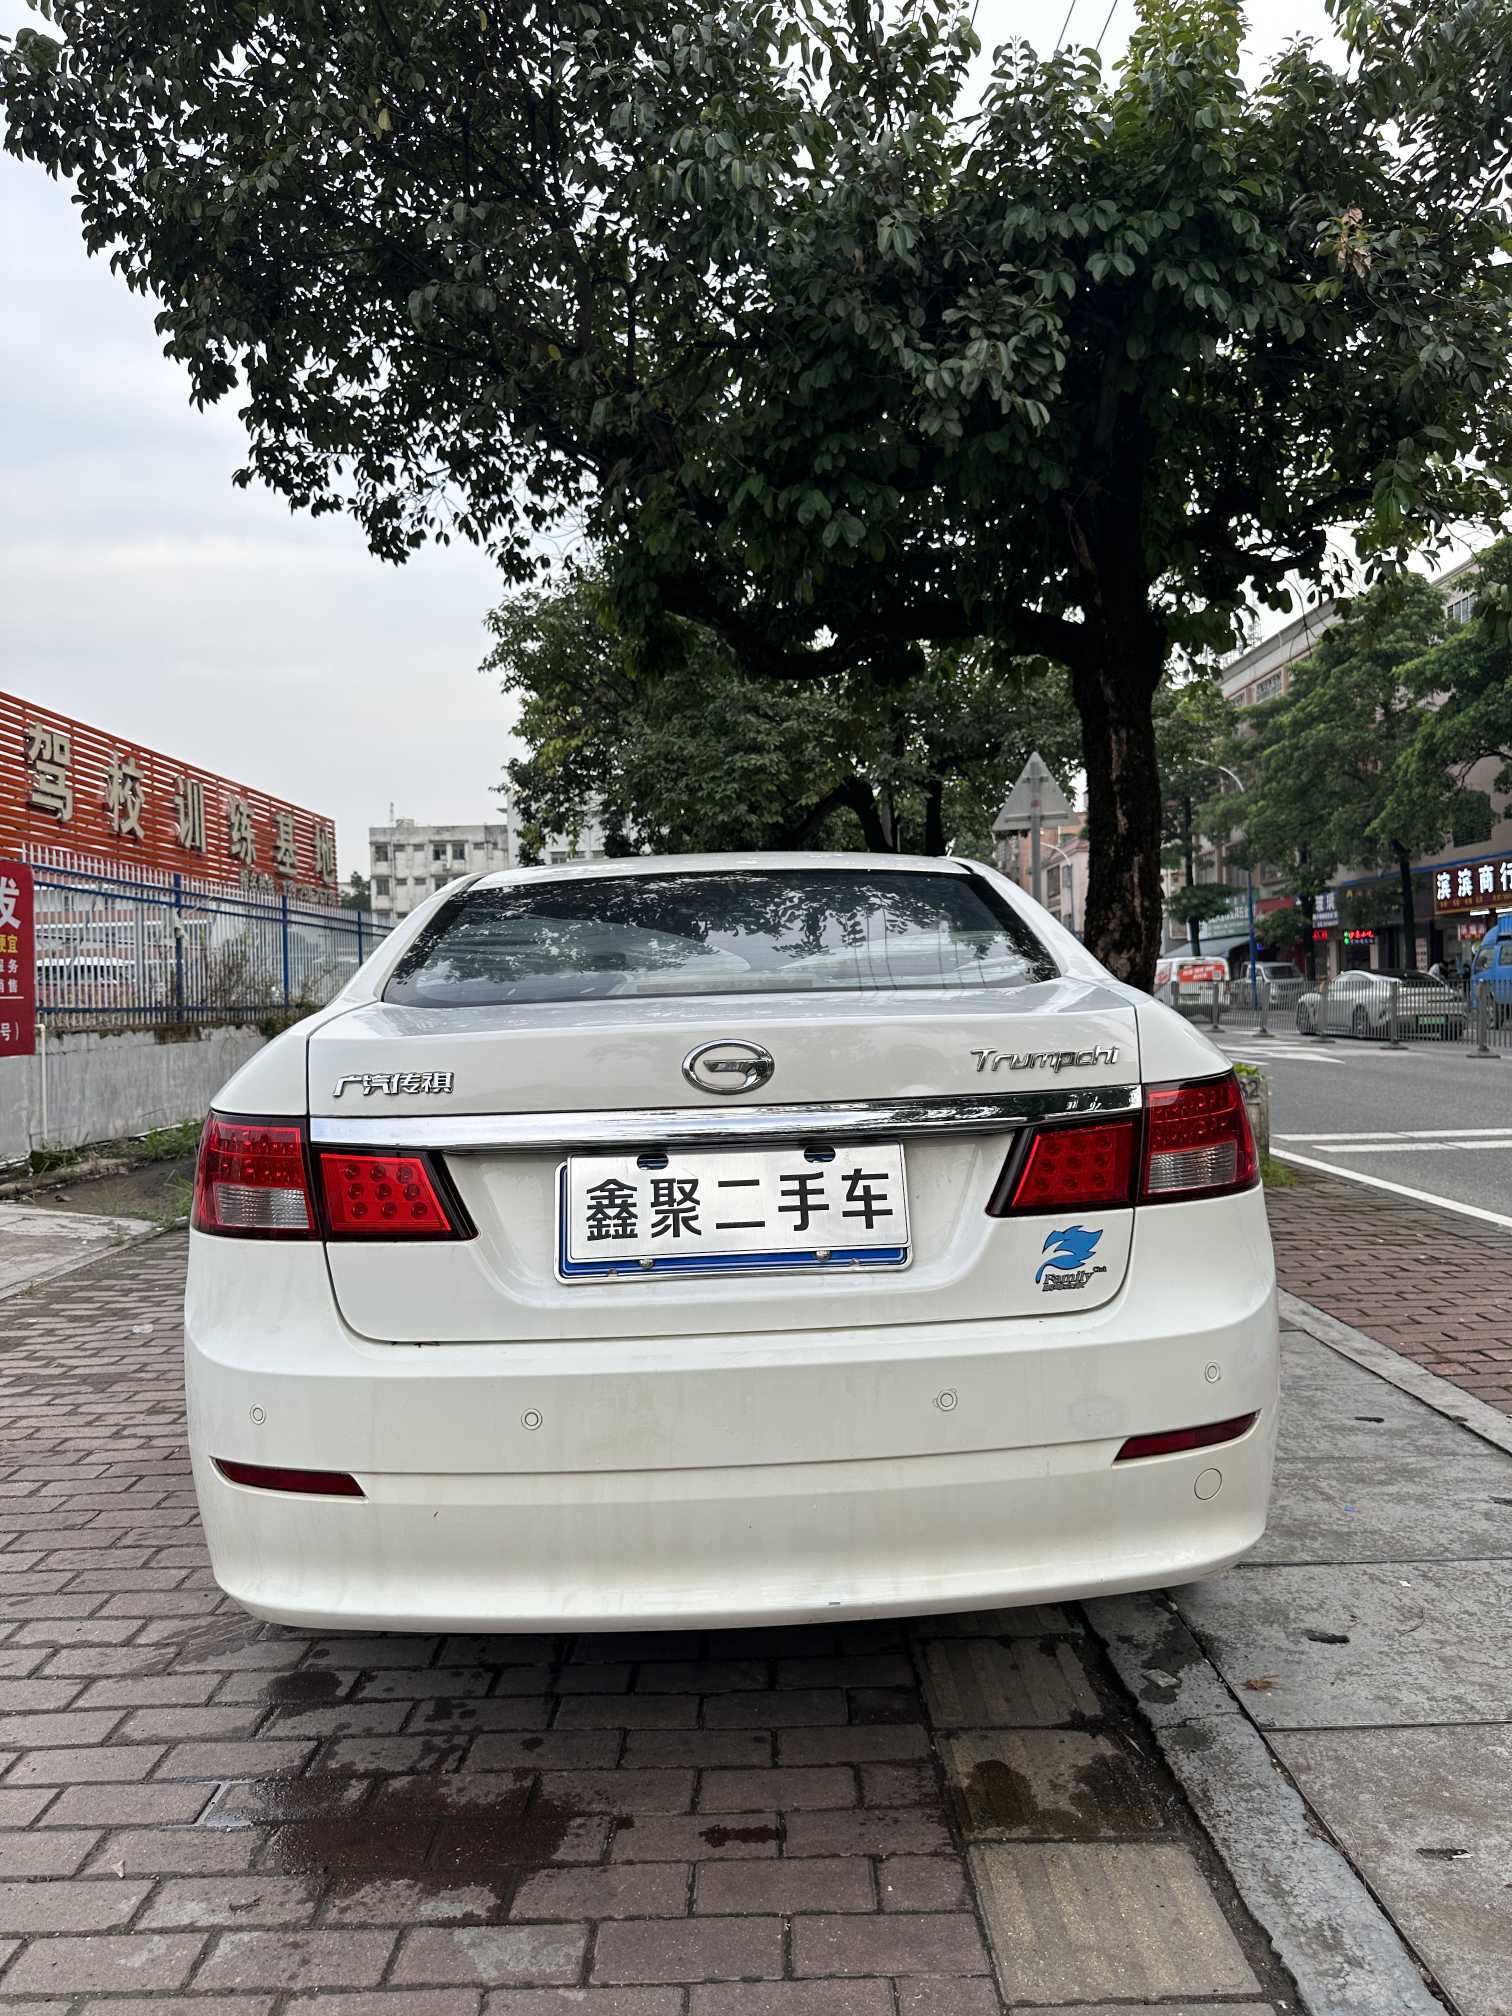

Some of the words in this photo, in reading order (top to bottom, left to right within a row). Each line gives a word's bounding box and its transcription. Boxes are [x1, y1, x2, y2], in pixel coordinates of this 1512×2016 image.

[24, 722, 335, 884] 驾校训练基地
[332, 1071, 454, 1098] 广汽传祺
[971, 1045, 1120, 1073] Trumpchi
[586, 1168, 894, 1242] 鑫聚二手车
